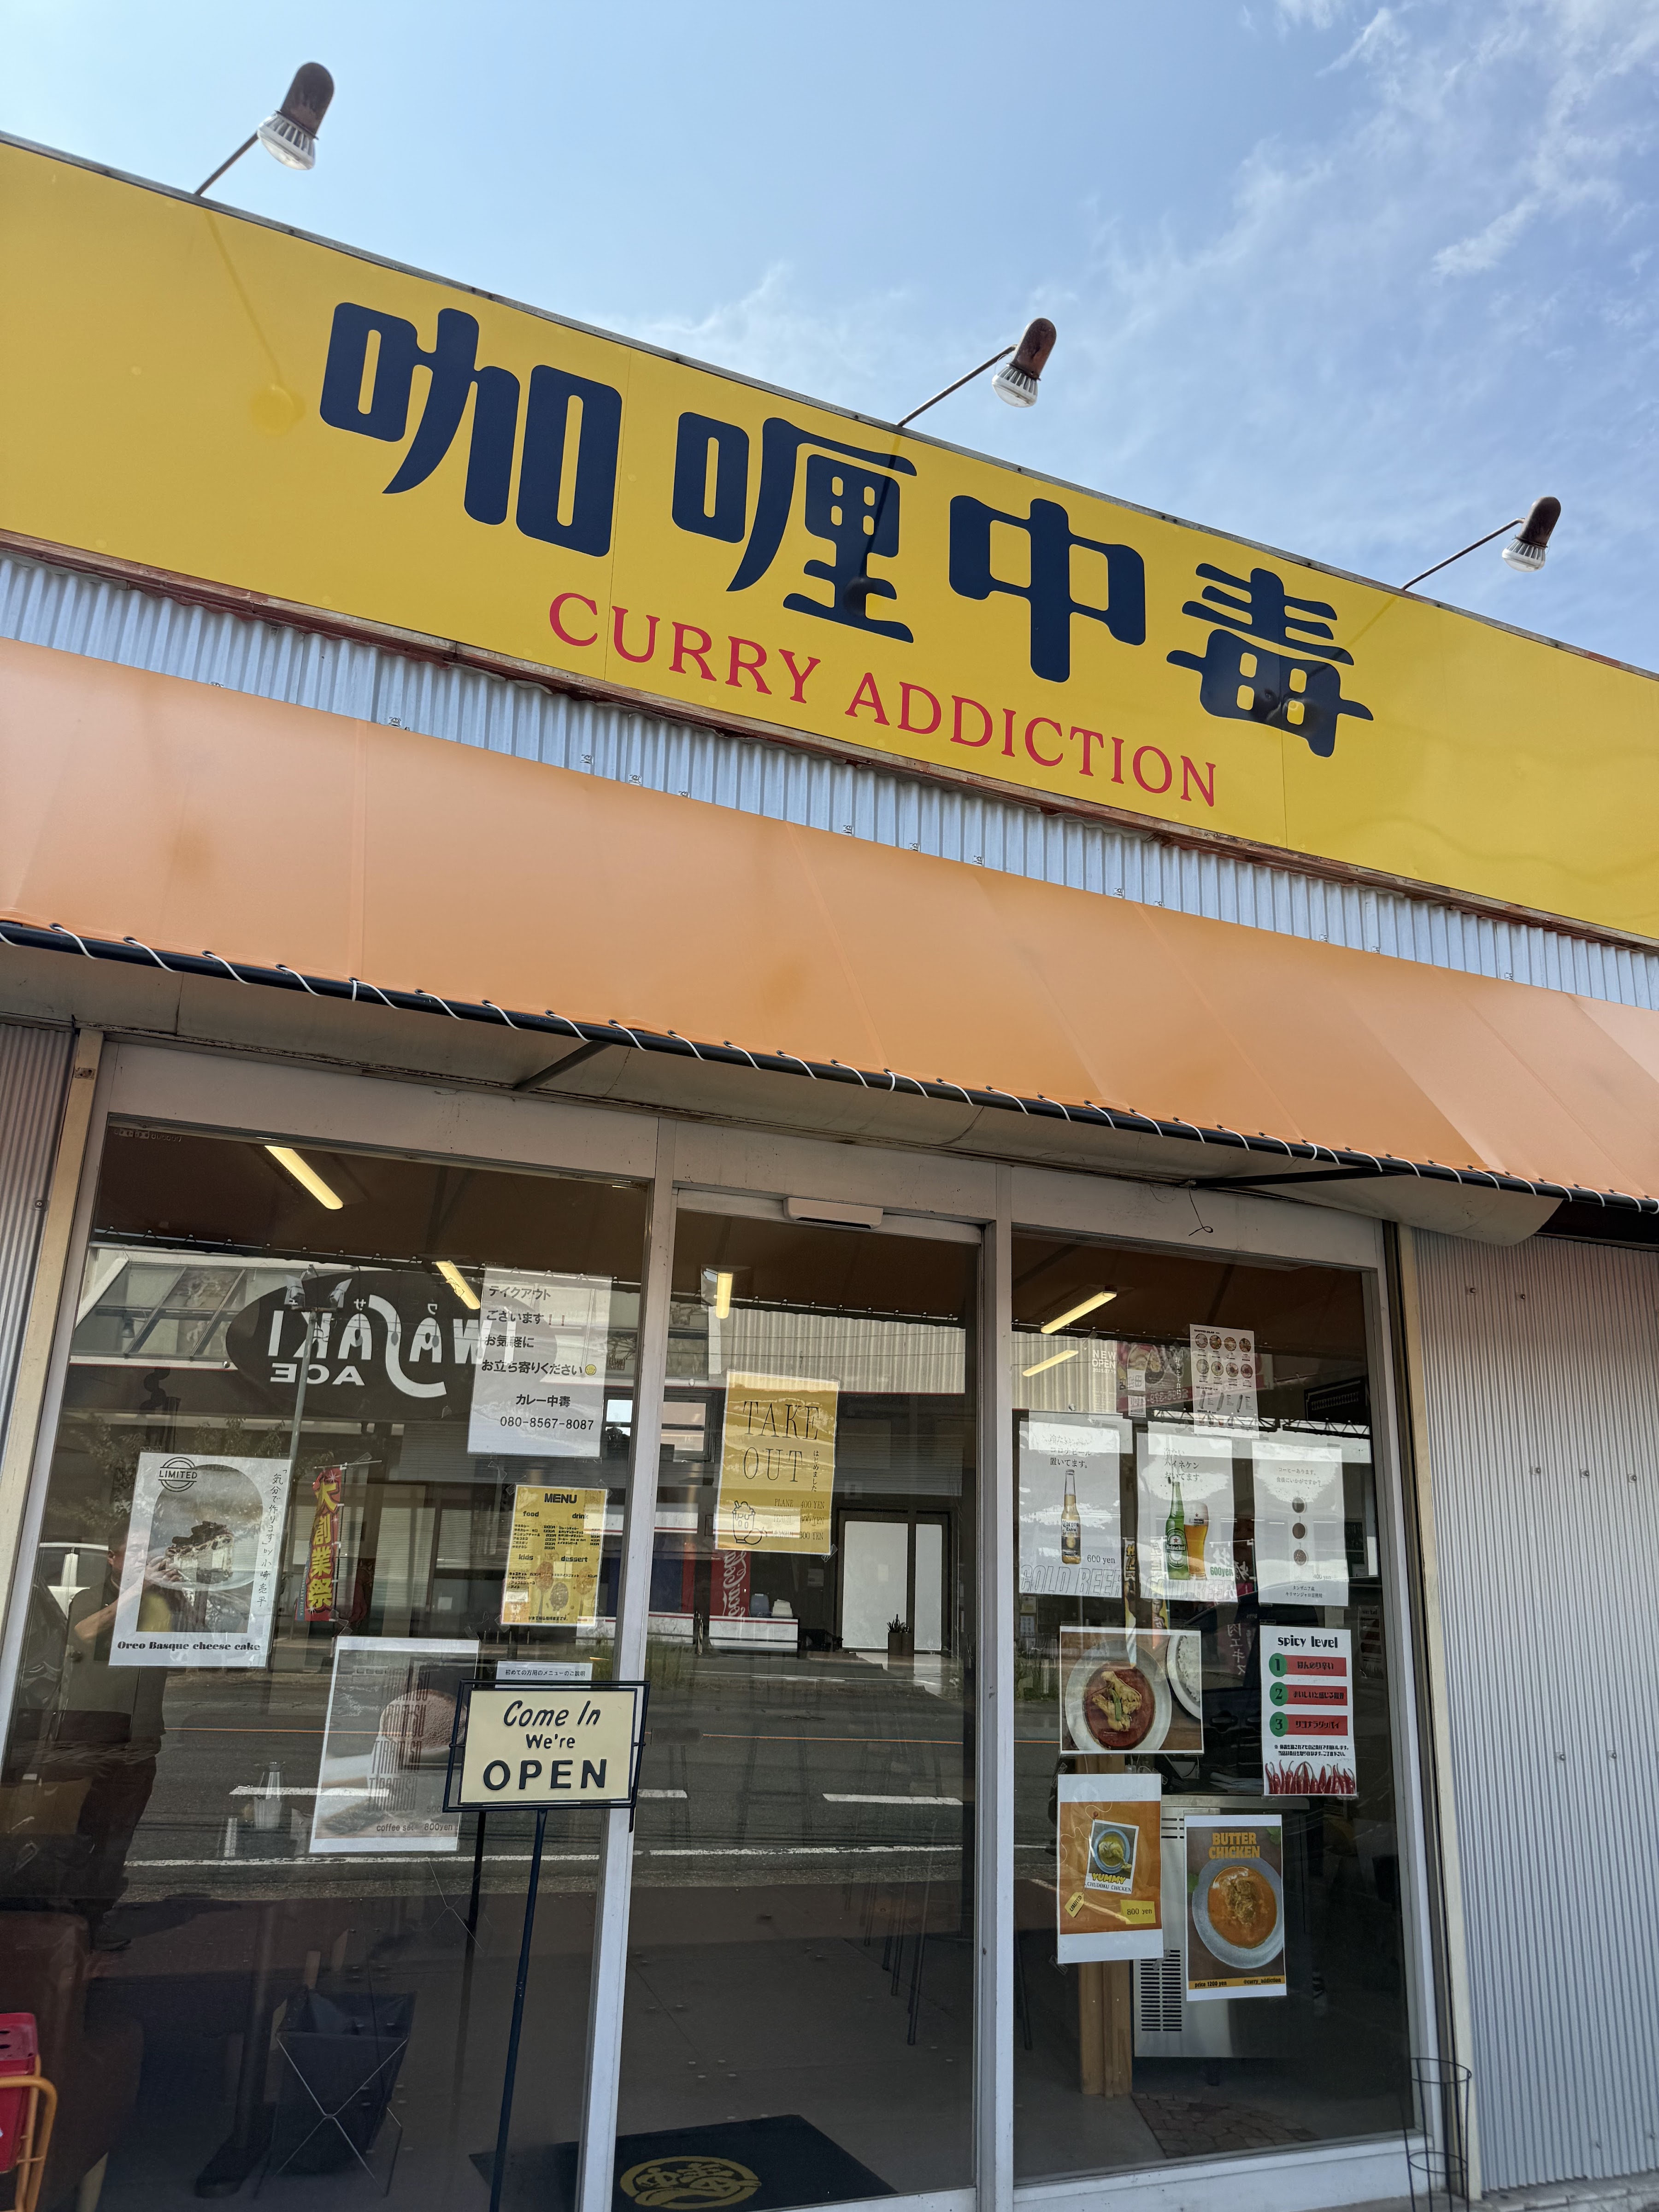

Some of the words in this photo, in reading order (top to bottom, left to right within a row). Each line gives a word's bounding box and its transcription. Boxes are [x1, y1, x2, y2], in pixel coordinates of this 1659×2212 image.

[320, 302, 1374, 758] 咖喱中毒
[549, 592, 821, 703] CURRY
[844, 671, 1216, 807] ADDICTION
[489, 1285, 551, 1300] テイクアウト
[484, 1335, 535, 1347] お気軽に
[1093, 1350, 1116, 1360] NEW
[482, 1359, 583, 1376] お立ち寄りください
[1092, 1359, 1116, 1369] OPEN
[516, 1394, 571, 1407] カレー中毒
[500, 1416, 594, 1430] 080-8567-8087
[743, 1401, 819, 1440] TAKE
[1051, 1447, 1091, 1456] コロナビール
[744, 1447, 802, 1483] OUT
[1050, 1457, 1088, 1468] 置いてます。
[1164, 1460, 1200, 1470] ハイネケン
[159, 1470, 198, 1479] LIMITED
[812, 1450, 820, 1492] はじめました
[544, 1493, 577, 1504] MENU
[775, 1499, 794, 1507] PLANE
[813, 1501, 824, 1509] YEN
[812, 1532, 824, 1540] YEN
[308, 1478, 338, 1609] 大創業祭
[1087, 1554, 1100, 1563] 600
[1102, 1556, 1116, 1565] yen
[1075, 1567, 1121, 1596] BEER
[118, 1641, 146, 1650] Oreo
[149, 1641, 189, 1652] Basque
[192, 1641, 231, 1651] cheese
[234, 1642, 261, 1652] cake
[1277, 1635, 1306, 1647] spicy
[1311, 1636, 1338, 1648] level
[1275, 1659, 1280, 1671] 1
[1275, 1688, 1282, 1700] 2
[503, 1700, 569, 1727] Come
[577, 1700, 601, 1726] In
[1275, 1719, 1282, 1730] 3
[526, 1734, 576, 1749] We're
[371, 1740, 423, 1774] TIRAMISU
[483, 1759, 607, 1791] OPEN
[376, 1824, 401, 1832] coffee
[424, 1823, 453, 1832] 800yen
[1212, 1832, 1257, 1845] BUTTER
[1209, 1846, 1260, 1859] CHICKEN
[1091, 1873, 1126, 1884] YUMMY
[1069, 1895, 1082, 1912] LIMITED
[1243, 1977, 1282, 1986] @curry_addiction
